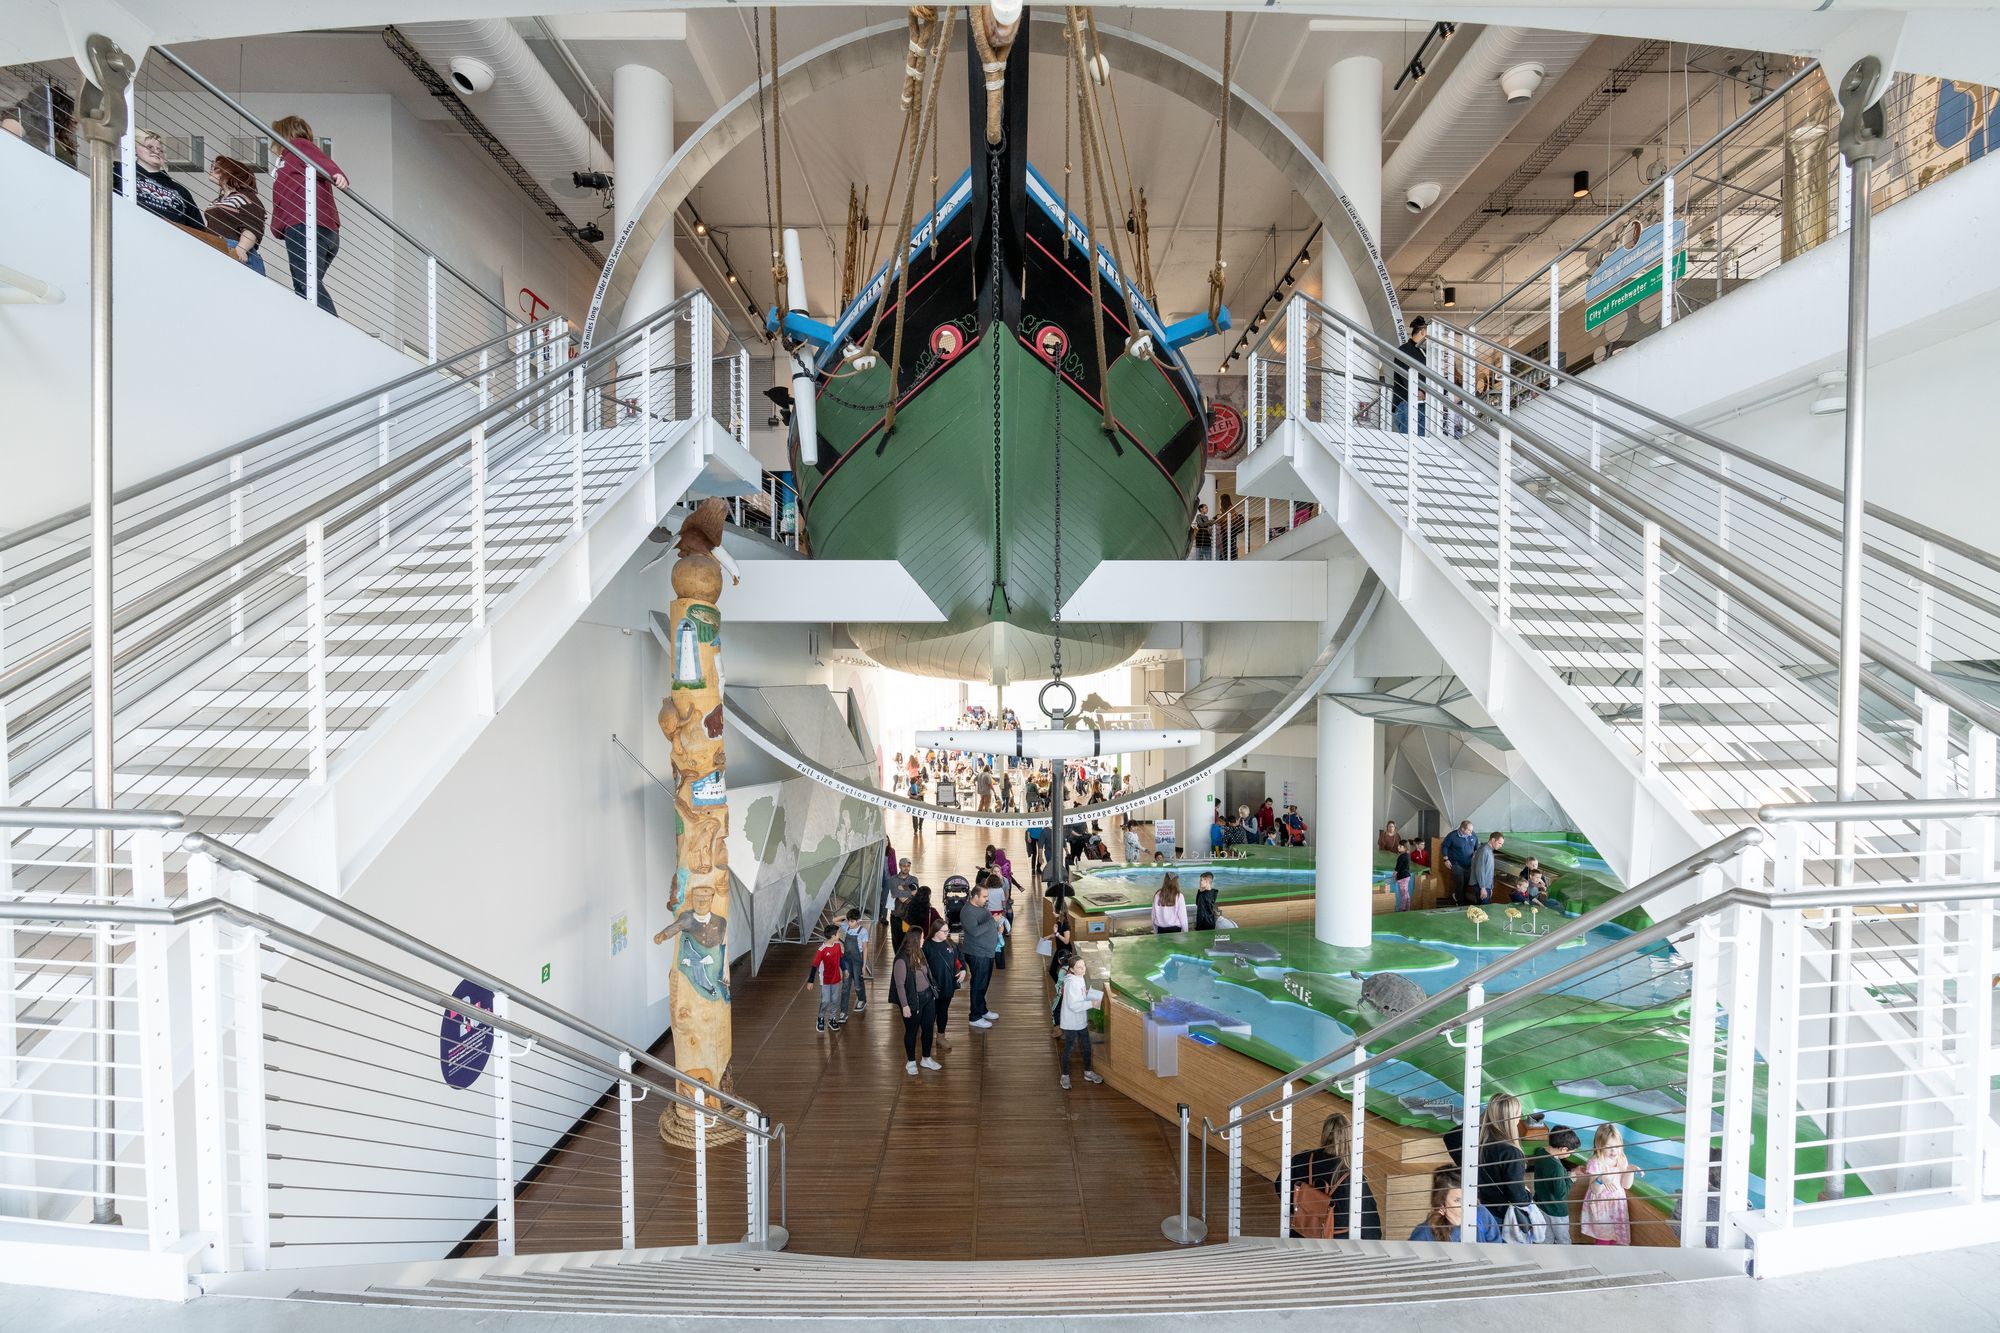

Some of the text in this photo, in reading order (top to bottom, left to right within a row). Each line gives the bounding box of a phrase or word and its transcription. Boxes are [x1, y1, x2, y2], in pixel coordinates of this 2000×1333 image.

[1339, 194, 1351, 210] Full
[1347, 207, 1357, 220] size
[623, 220, 635, 236] Area
[1354, 219, 1370, 244] section
[611, 234, 627, 259] Service
[1366, 240, 1375, 250] of
[1370, 248, 1379, 260] the
[602, 258, 616, 279] MMSD
[595, 276, 607, 300] Under
[1589, 282, 1648, 322] City of Freshwater
[588, 306, 599, 322] long
[585, 322, 594, 341] miles
[1397, 324, 1407, 344] Gigan
[797, 763, 814, 777] Full
[816, 774, 833, 786] size
[836, 783, 867, 800] section
[883, 800, 898, 809] the
[985, 818, 1023, 827] Gigantic
[1027, 817, 1074, 827] Tempry
[1078, 809, 1112, 821] Storage
[1115, 799, 1146, 813] System
[1149, 794, 1162, 803] for
[1164, 769, 1213, 796] Stormwater
[543, 967, 549, 981] 2
[1283, 975, 1313, 1007] ERIE
